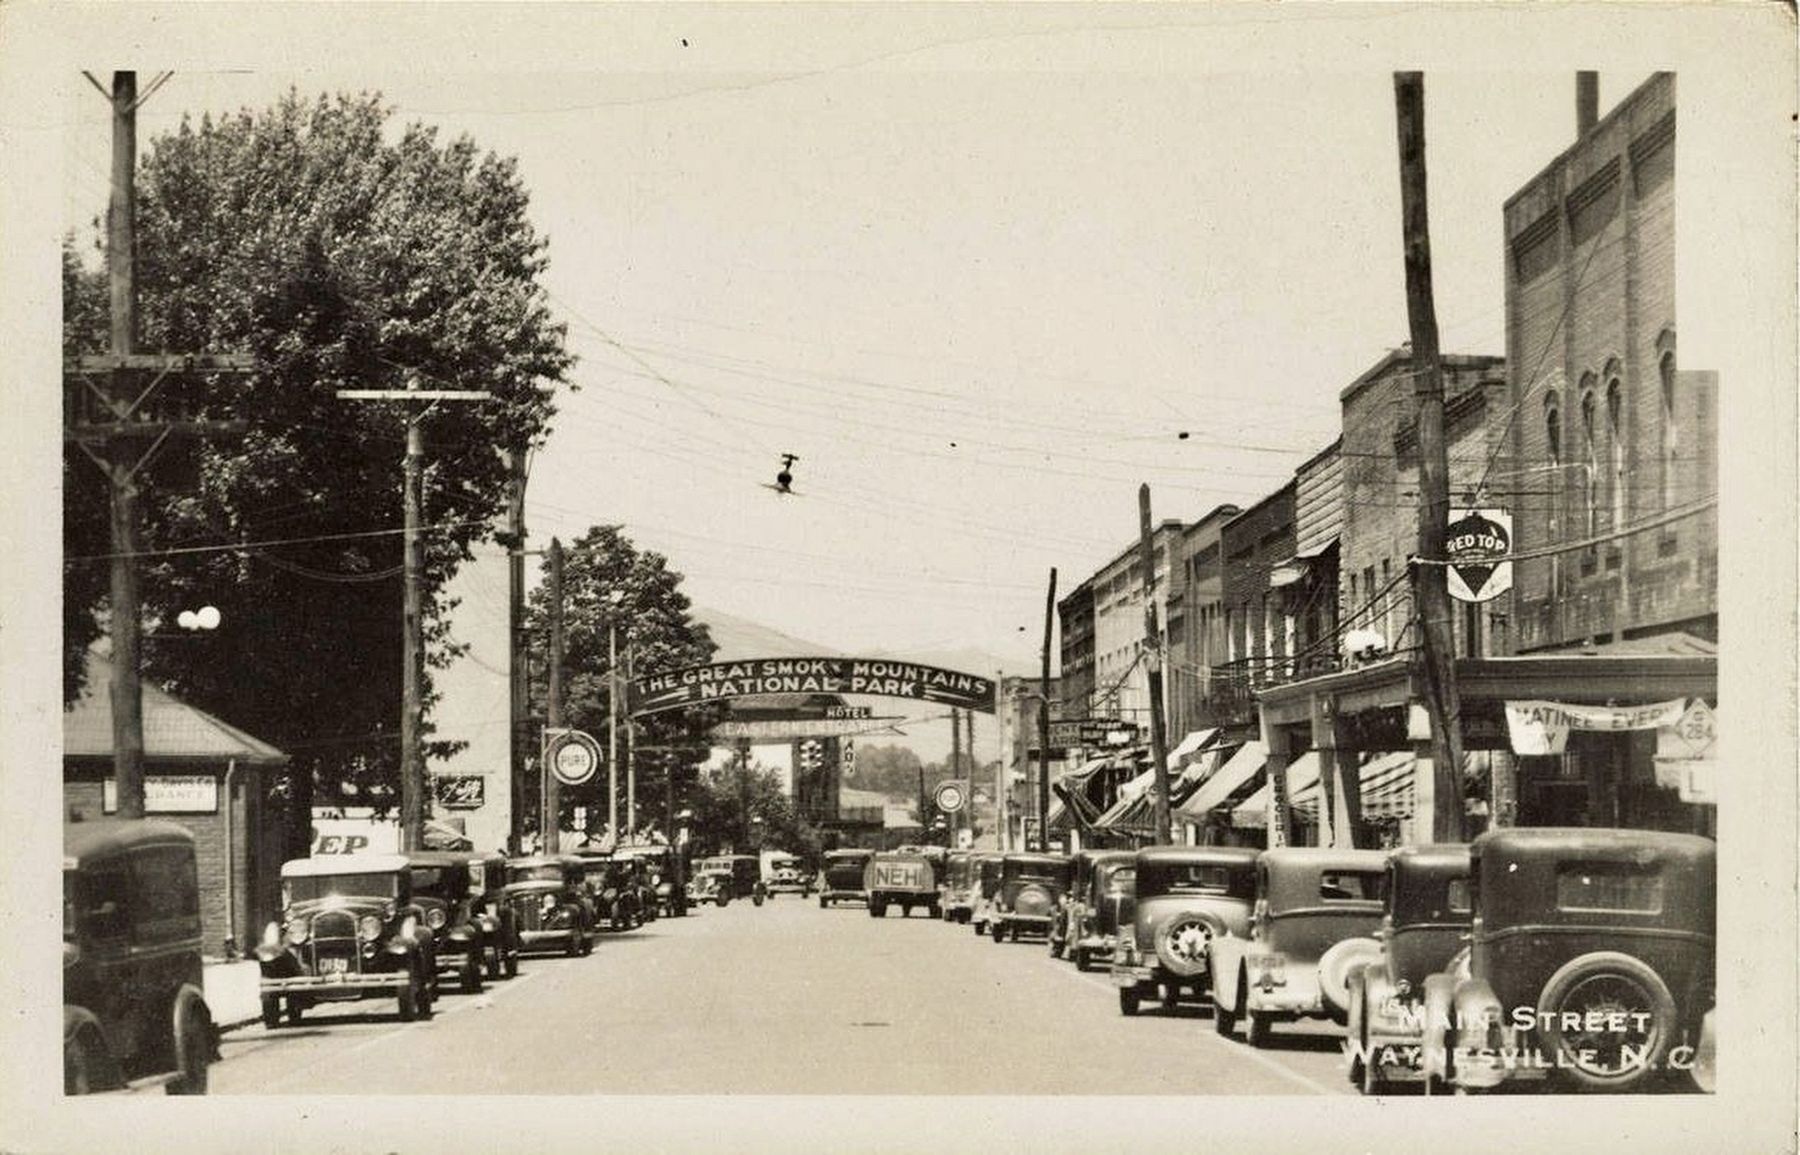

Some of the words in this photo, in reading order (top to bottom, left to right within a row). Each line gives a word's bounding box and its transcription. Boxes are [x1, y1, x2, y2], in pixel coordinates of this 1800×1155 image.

[1447, 534, 1475, 553] RED
[1477, 534, 1505, 551] TOP
[635, 674, 677, 695] THE
[682, 662, 755, 685] GREAT
[852, 662, 987, 695] MOUNTAINS
[701, 676, 840, 699] NATIONAL
[851, 678, 917, 697] PARK
[826, 706, 869, 718] HOTEL
[1611, 706, 1669, 728] EVER
[560, 754, 587, 767] PURE
[876, 867, 922, 886] NEHI
